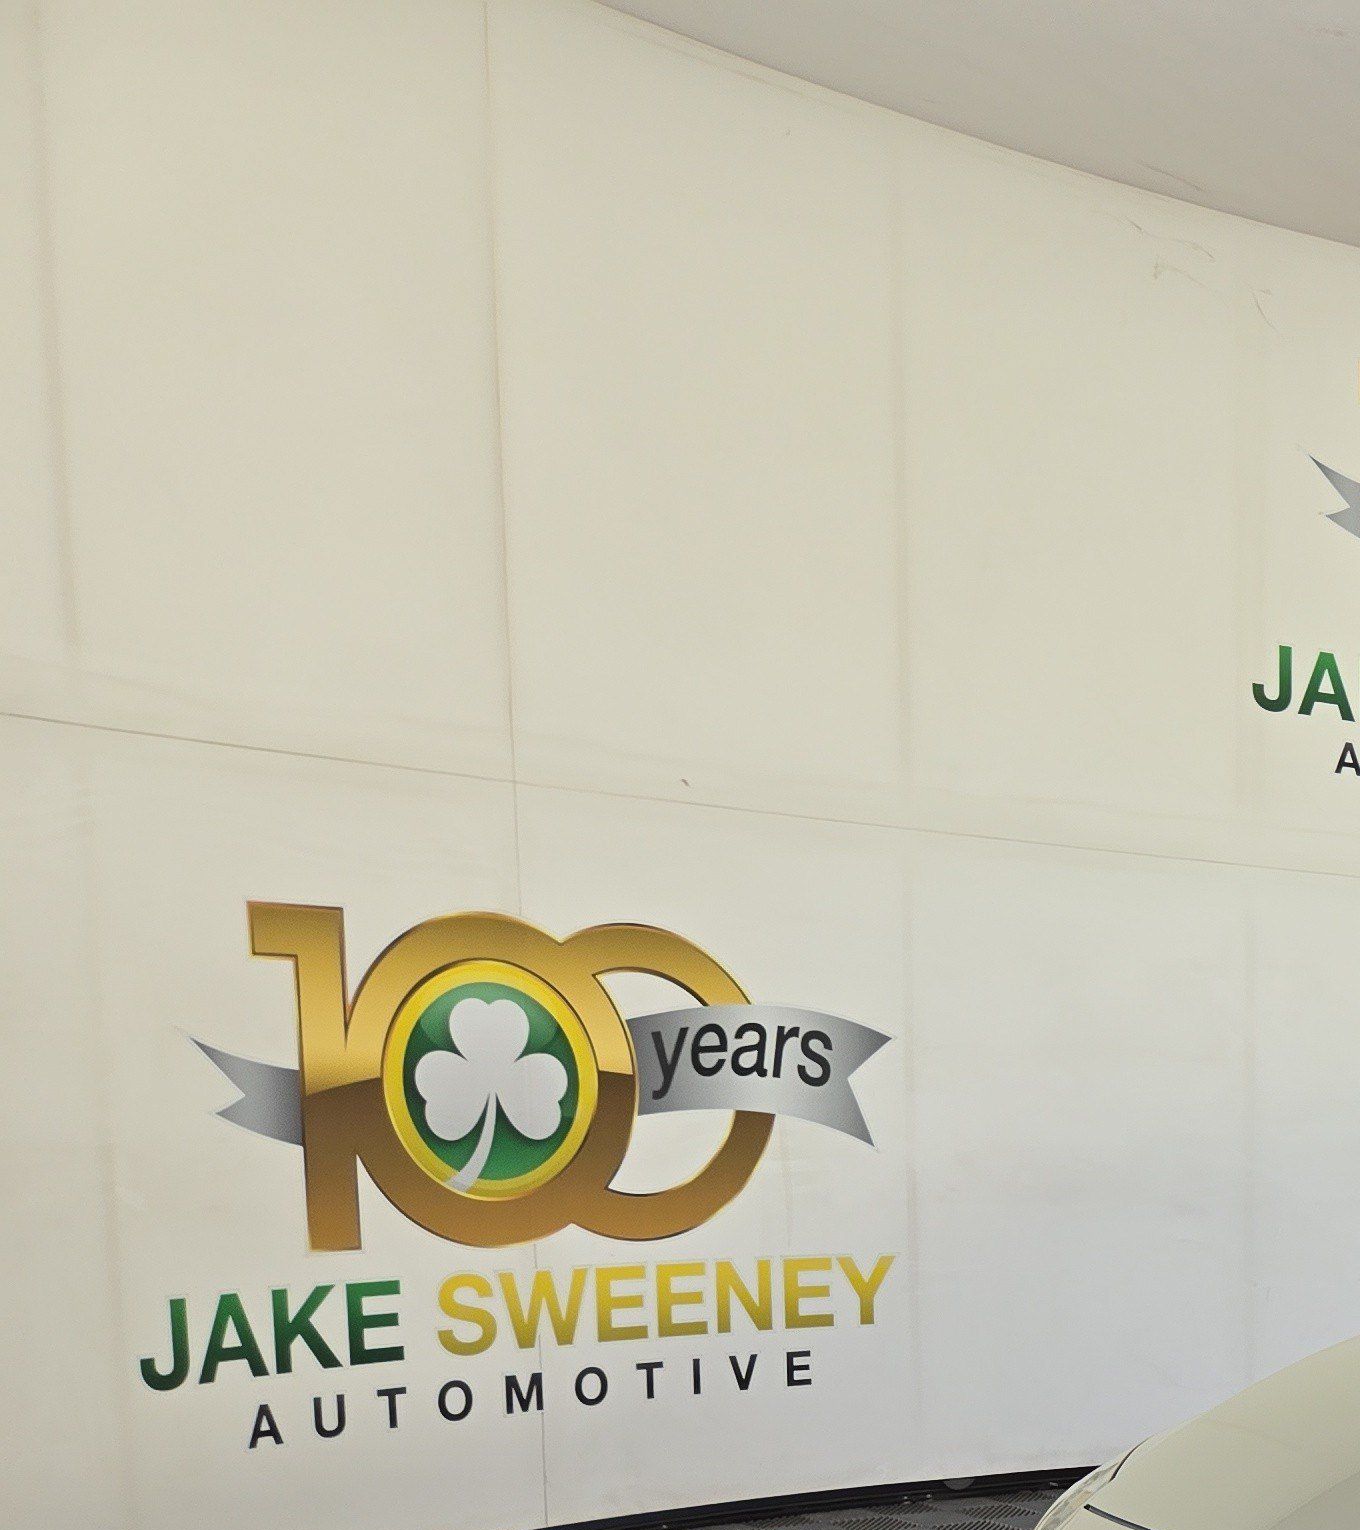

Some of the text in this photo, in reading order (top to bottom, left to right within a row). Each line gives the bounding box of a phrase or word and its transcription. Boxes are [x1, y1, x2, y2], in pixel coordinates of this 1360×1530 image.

[246, 901, 834, 1253] 100 years
[139, 1255, 896, 1392] JAKE SWEENEY
[248, 1350, 813, 1449] AUTOMOTIVE
